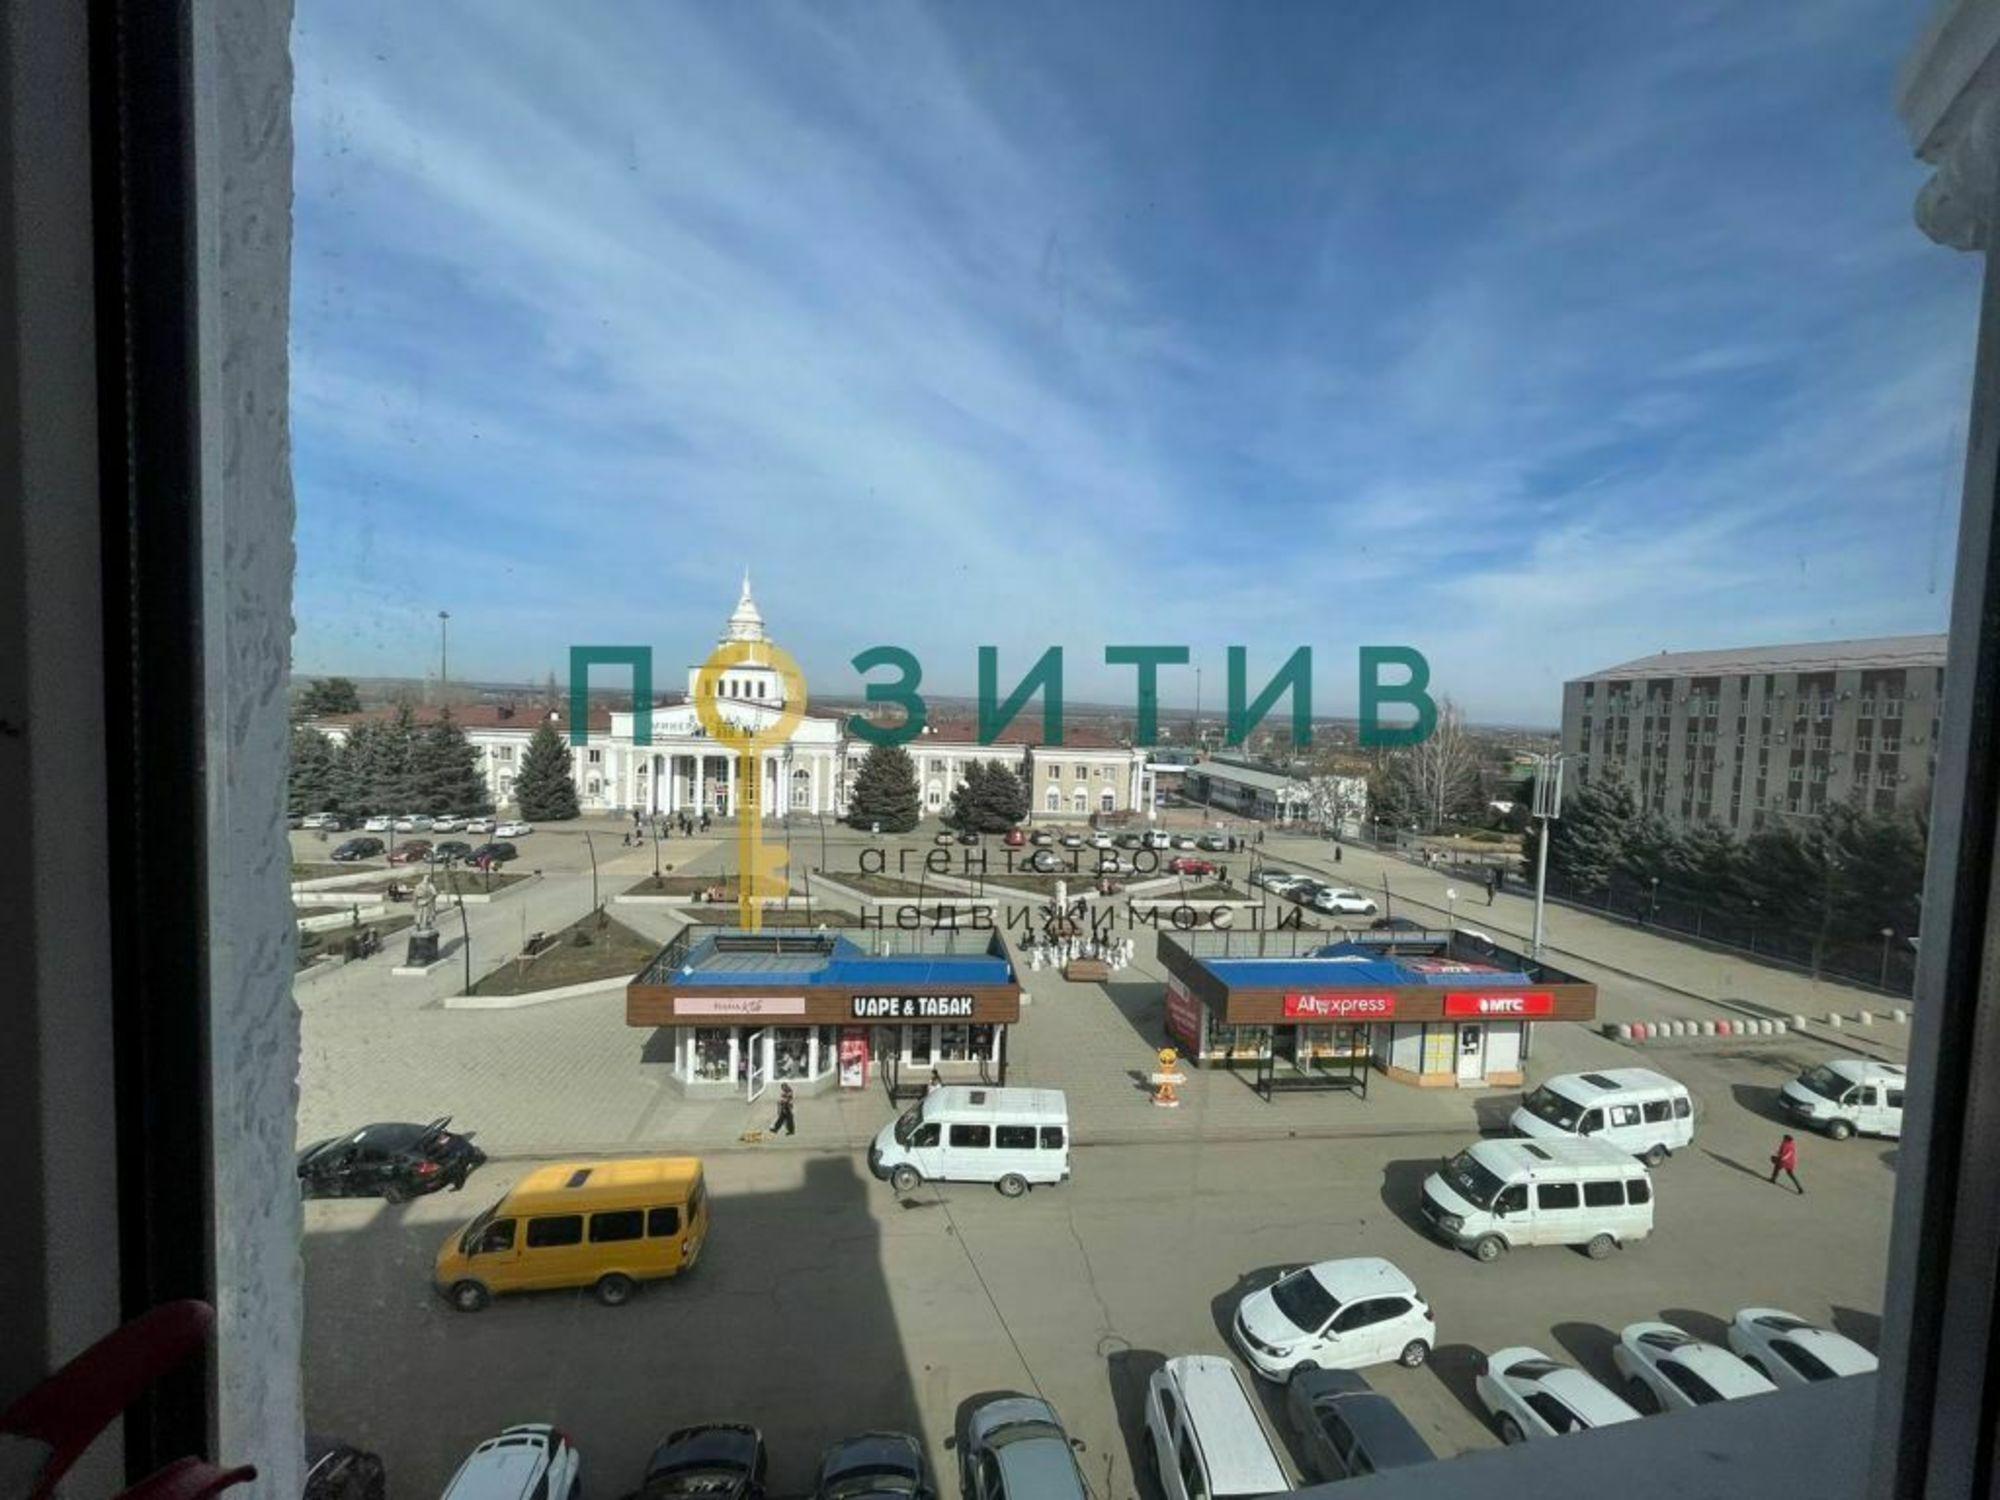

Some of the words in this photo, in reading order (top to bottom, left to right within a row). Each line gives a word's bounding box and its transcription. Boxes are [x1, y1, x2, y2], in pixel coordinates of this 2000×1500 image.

[854, 997, 899, 1016] VAPE
[903, 999, 915, 1016] &
[918, 997, 972, 1015] ТАБАК
[1489, 999, 1524, 1011] МТС
